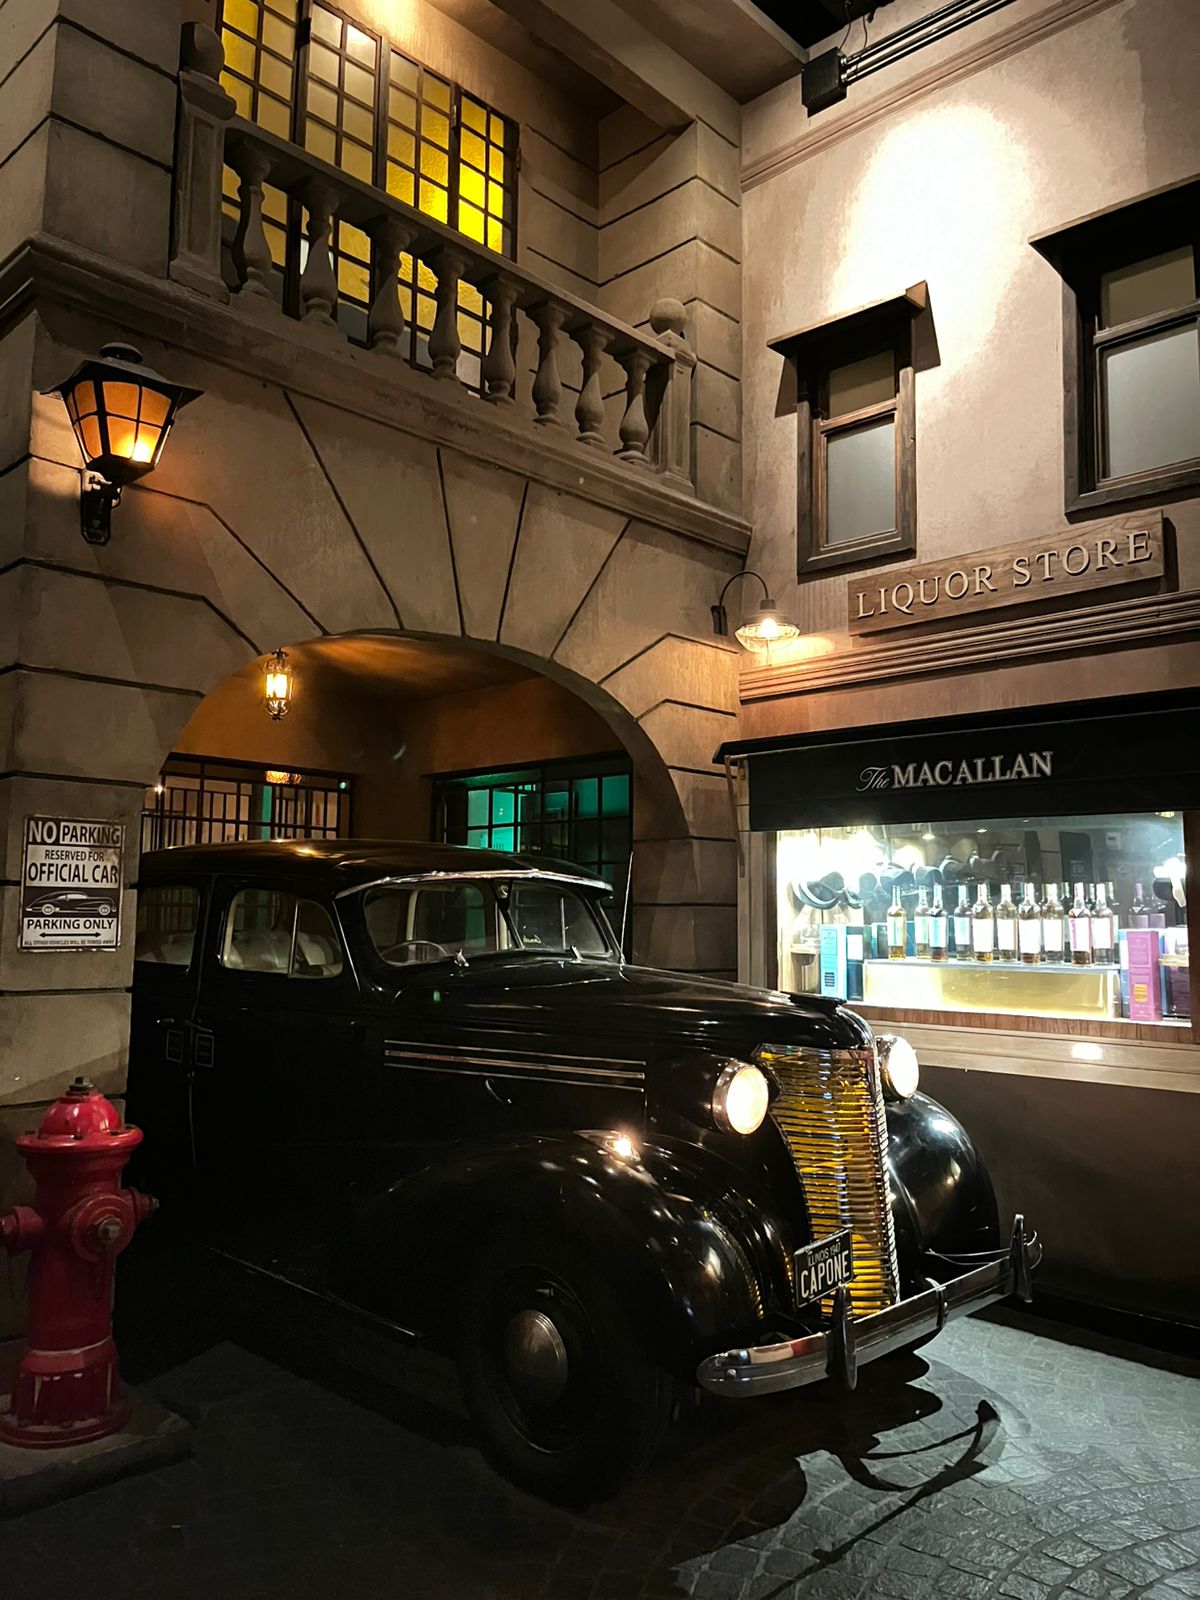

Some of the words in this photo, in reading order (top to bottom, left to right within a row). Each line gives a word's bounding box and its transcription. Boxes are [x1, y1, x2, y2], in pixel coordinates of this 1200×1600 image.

[857, 565, 994, 619] LIQUOR
[1013, 530, 1153, 587] STORE
[856, 766, 890, 792] The
[890, 751, 1054, 789] MACALLAN
[28, 820, 58, 844] NO
[62, 825, 120, 845] PARKING
[45, 849, 87, 861] RESERVED
[88, 851, 105, 862] FOR
[28, 862, 88, 882] OFFICIAL
[92, 865, 119, 884] CAR
[27, 919, 80, 930] PARKING
[83, 919, 114, 930] ONLY
[800, 1249, 850, 1298] CAPONE
